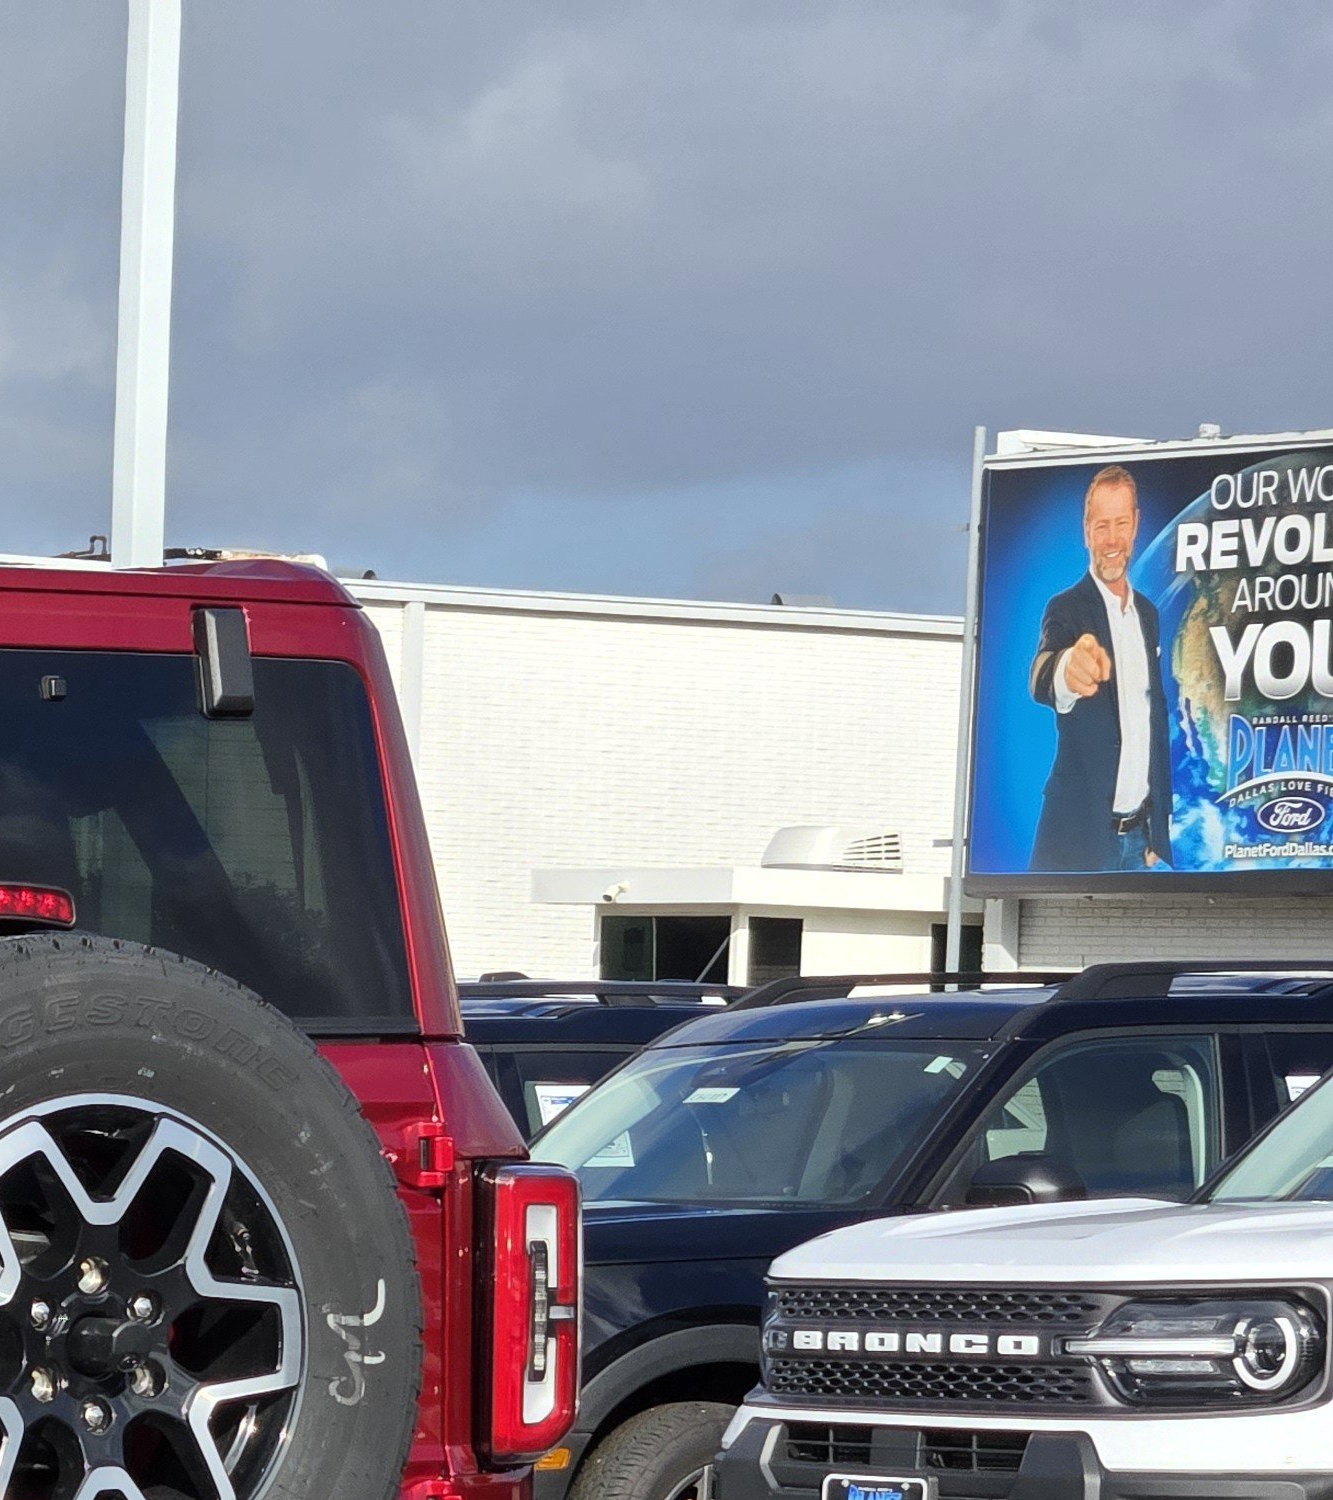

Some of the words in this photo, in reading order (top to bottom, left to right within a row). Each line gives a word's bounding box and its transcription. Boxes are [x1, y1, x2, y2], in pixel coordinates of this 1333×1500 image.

[1210, 470, 1279, 511] OUR
[1252, 714, 1298, 725] RANDALL
[1229, 782, 1275, 808] DALLAS
[1280, 780, 1312, 792] LOVE
[1269, 801, 1313, 827] Ford
[792, 1330, 1040, 1355] BRONCO
